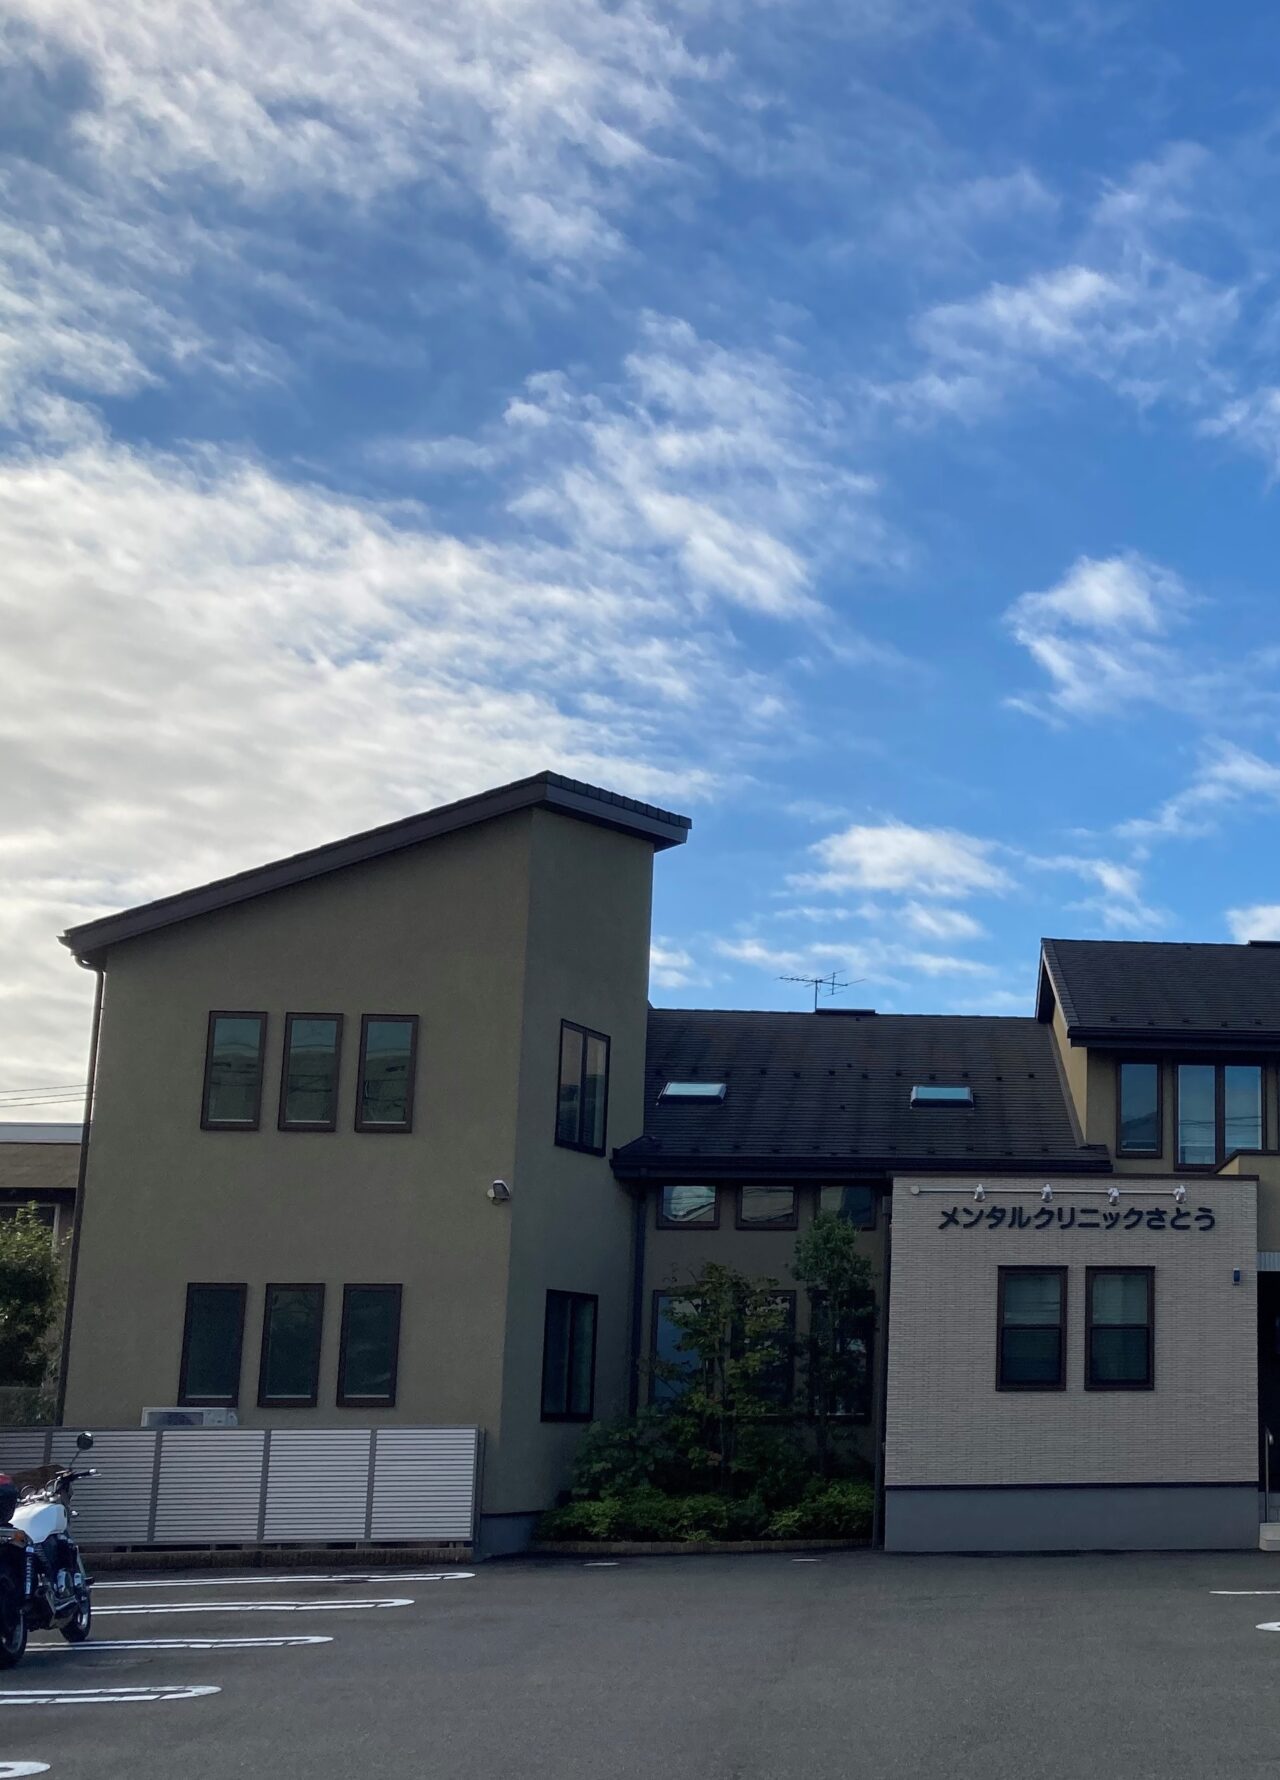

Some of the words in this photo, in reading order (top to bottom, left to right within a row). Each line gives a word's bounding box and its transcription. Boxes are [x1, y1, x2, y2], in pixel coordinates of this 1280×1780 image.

[938, 1206, 1216, 1231] メンタルクリニックさとう
